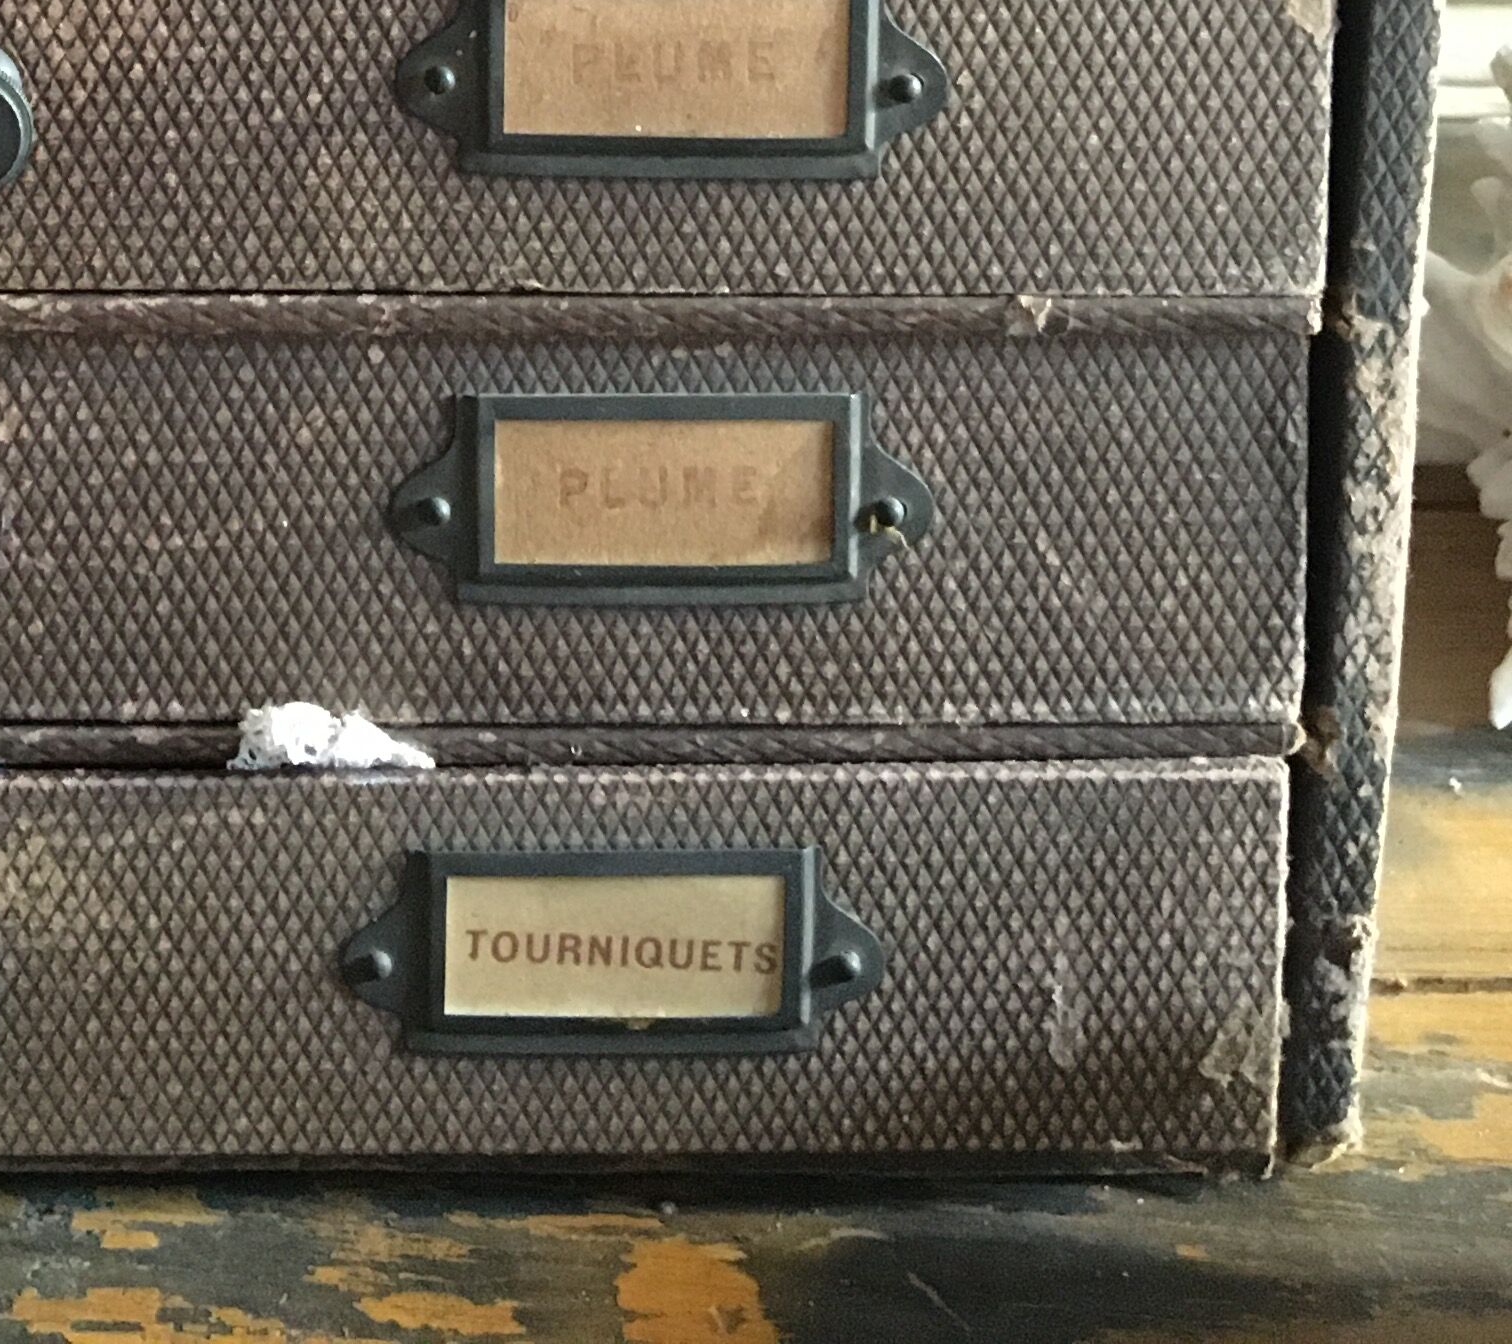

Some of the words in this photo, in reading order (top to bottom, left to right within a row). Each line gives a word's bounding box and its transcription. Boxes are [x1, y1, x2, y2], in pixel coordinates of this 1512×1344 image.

[571, 39, 776, 87] PLUME
[558, 464, 760, 510] PLUME
[464, 928, 779, 976] TOURNIQUETS
